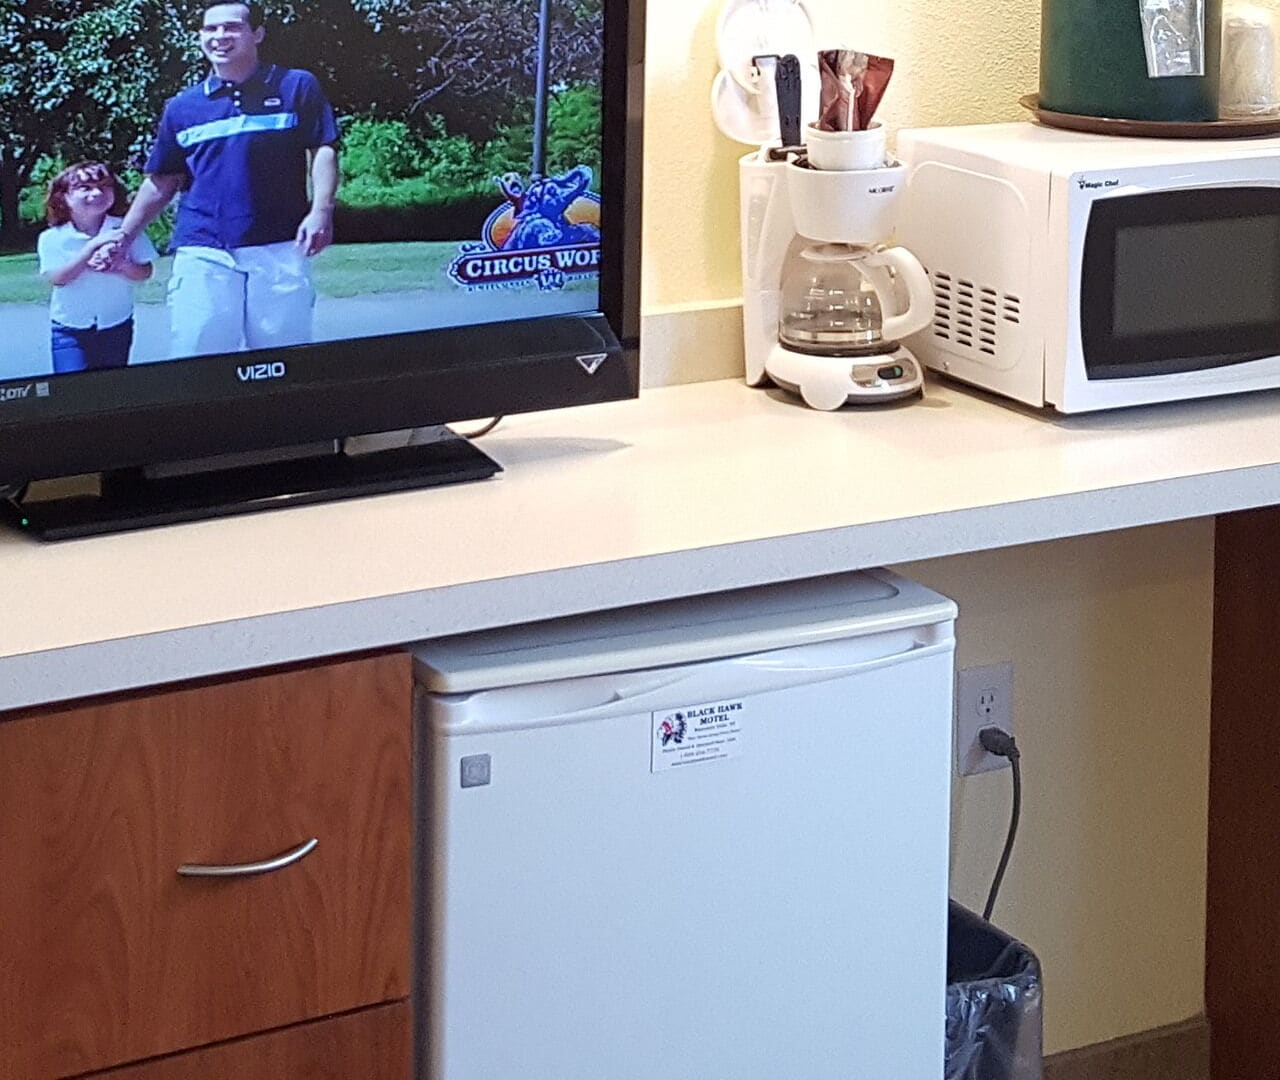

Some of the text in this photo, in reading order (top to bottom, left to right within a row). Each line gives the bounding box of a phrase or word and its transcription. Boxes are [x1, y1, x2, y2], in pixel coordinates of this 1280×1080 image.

[465, 254, 551, 278] CIRCUS
[237, 362, 286, 381] VIZIO
[687, 703, 742, 718] BLACK HAWK
[700, 714, 729, 725] MOTEL
